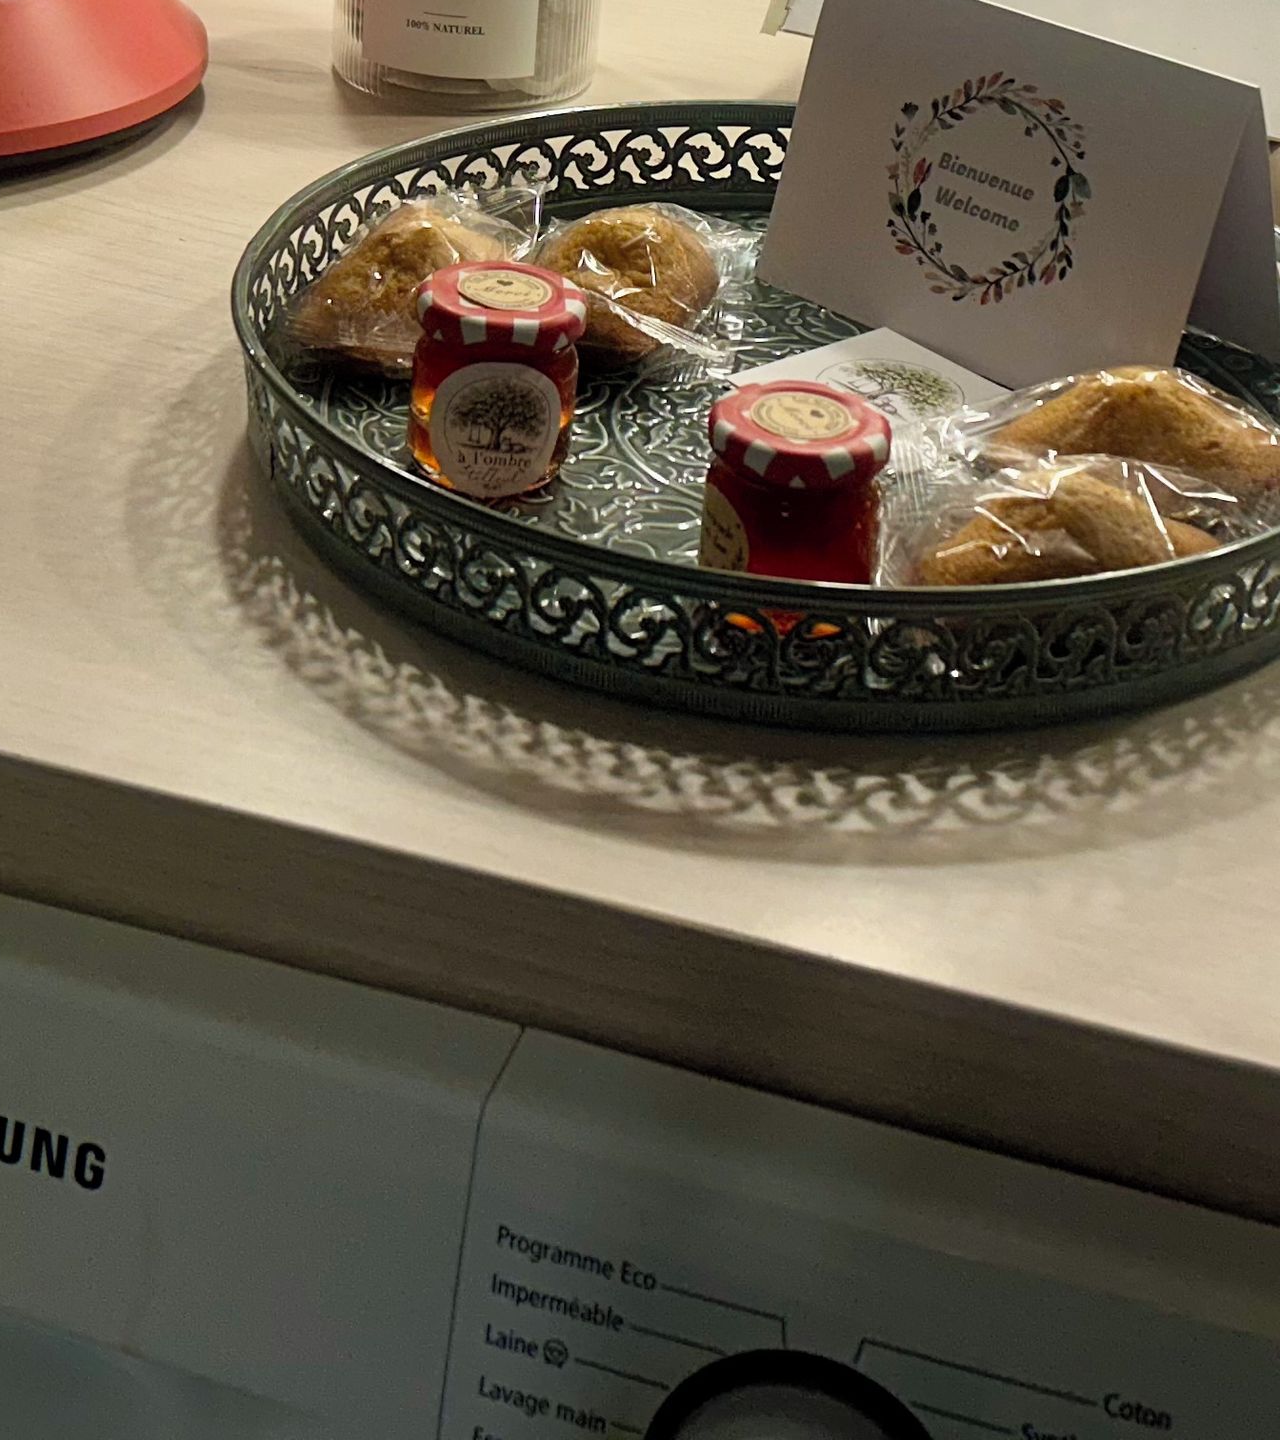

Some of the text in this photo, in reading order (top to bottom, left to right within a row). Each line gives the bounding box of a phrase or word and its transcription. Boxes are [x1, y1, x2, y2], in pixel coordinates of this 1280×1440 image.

[405, 18, 486, 36] 100% NATUREL
[938, 151, 1035, 202] Bienvenue
[934, 185, 1020, 233] Welcome
[496, 1224, 657, 1291] Programme Eco
[491, 1272, 625, 1332] Imperméable
[485, 1323, 539, 1358] Laine
[479, 1375, 608, 1435] Lavage main
[1103, 1393, 1173, 1431] Coton
